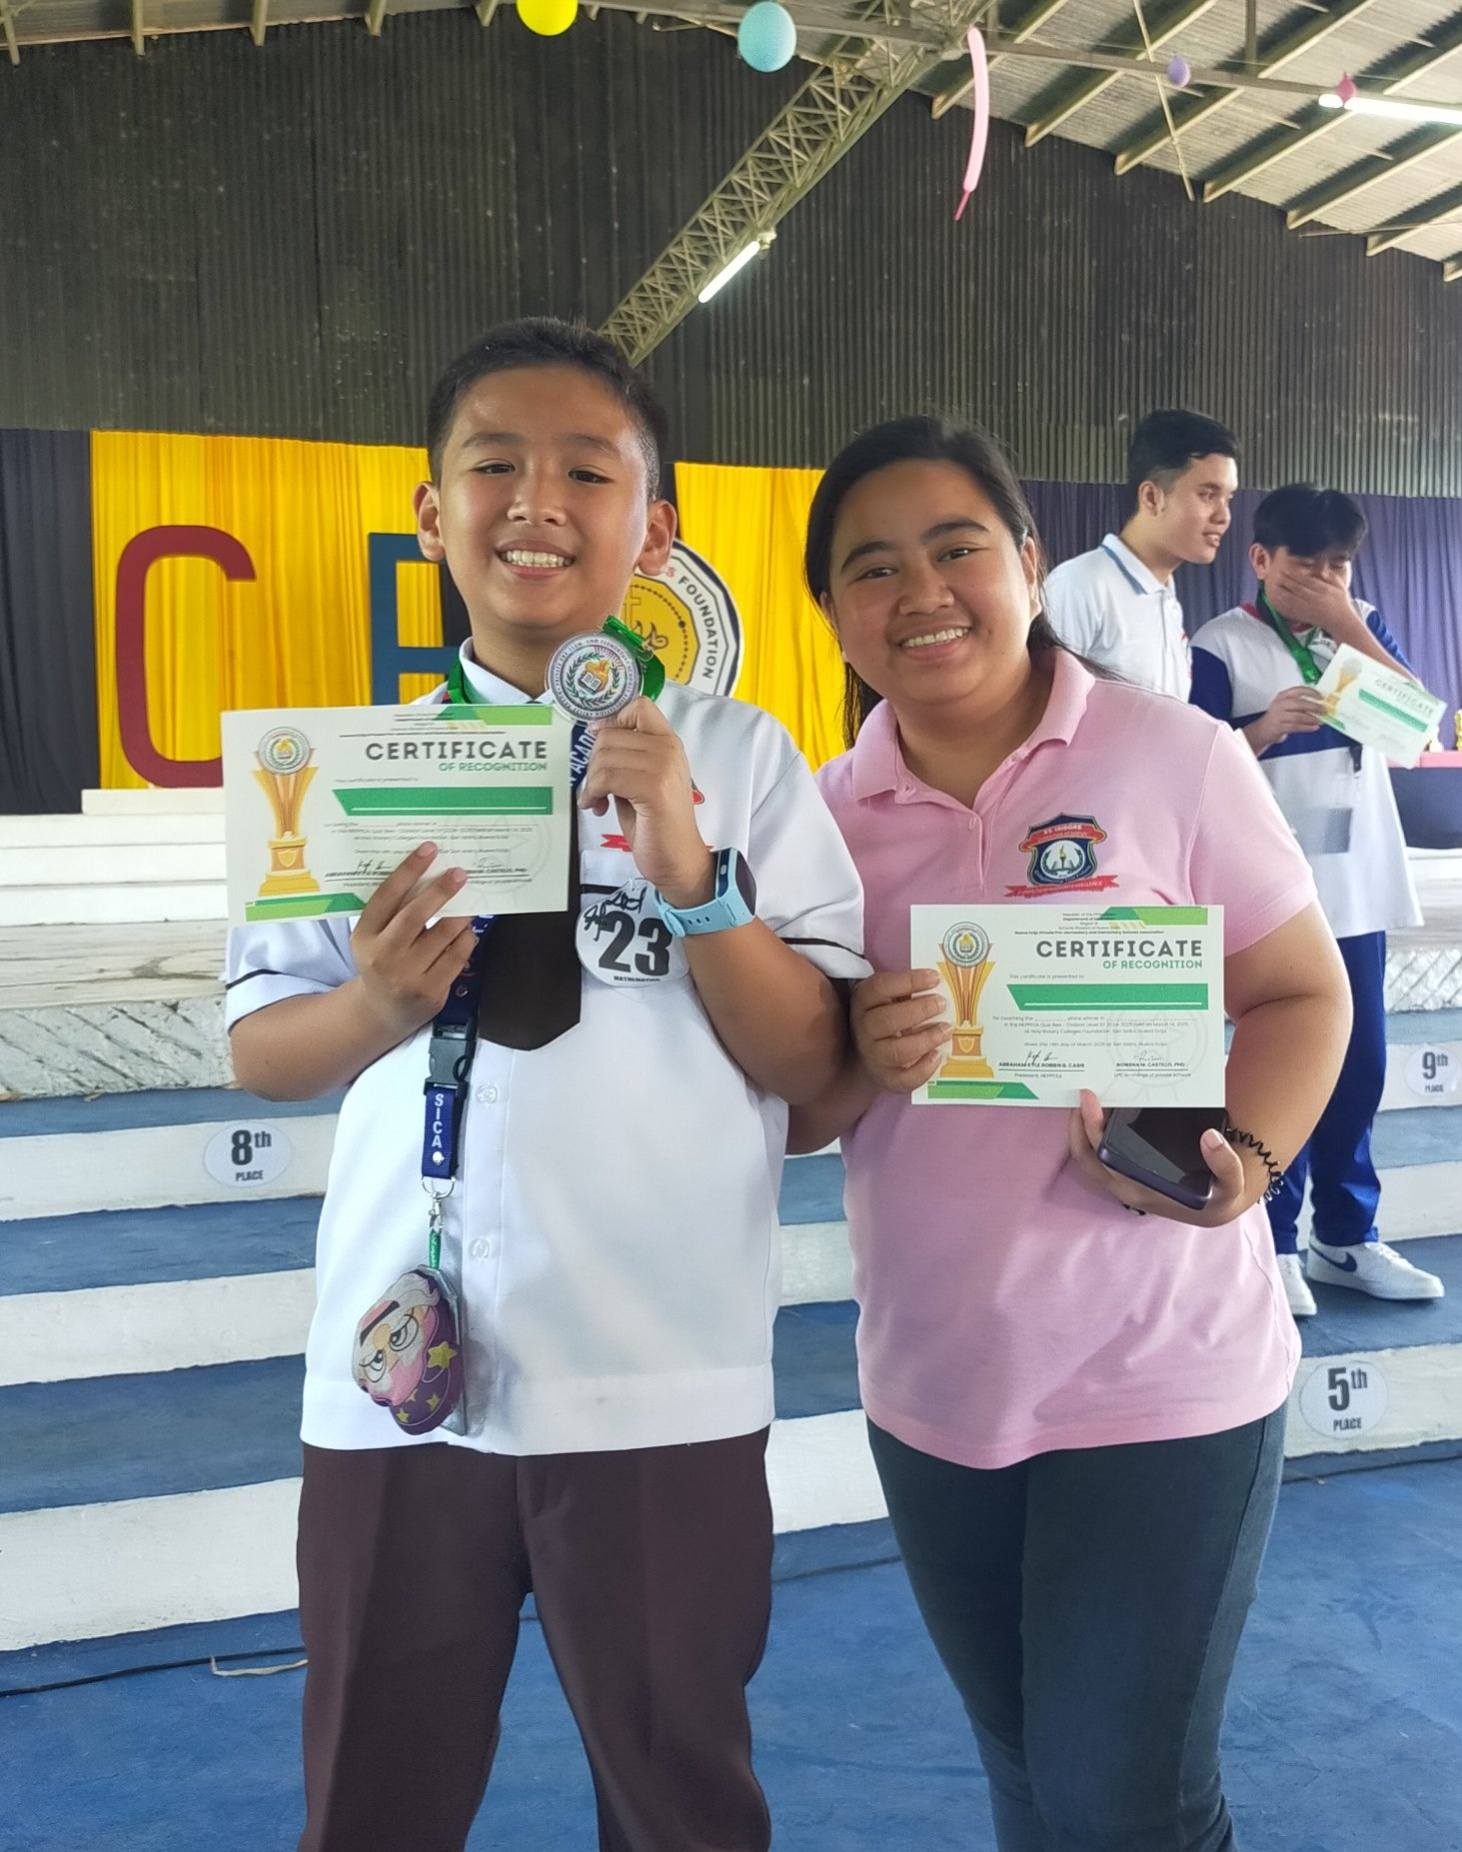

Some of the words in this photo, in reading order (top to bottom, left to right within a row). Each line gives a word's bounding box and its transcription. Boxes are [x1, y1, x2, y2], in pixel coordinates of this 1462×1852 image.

[678, 575, 719, 680] FOUNDATION
[365, 740, 548, 761] CERTIFICATE
[568, 727, 597, 775] ACAD
[438, 762, 455, 772] OF
[458, 761, 548, 772] RECOGNITION
[598, 910, 673, 976] 23
[1036, 940, 1203, 958] CERTIFICATE
[1102, 960, 1118, 969] OF
[1120, 959, 1203, 969] RECOGNITION
[1422, 1051, 1449, 1080] 9th
[431, 1092, 444, 1149] SICA
[231, 1129, 272, 1166] 8th
[235, 1169, 265, 1182] PLACE
[1328, 1366, 1369, 1411] 5th
[1333, 1416, 1362, 1432] PLACE
